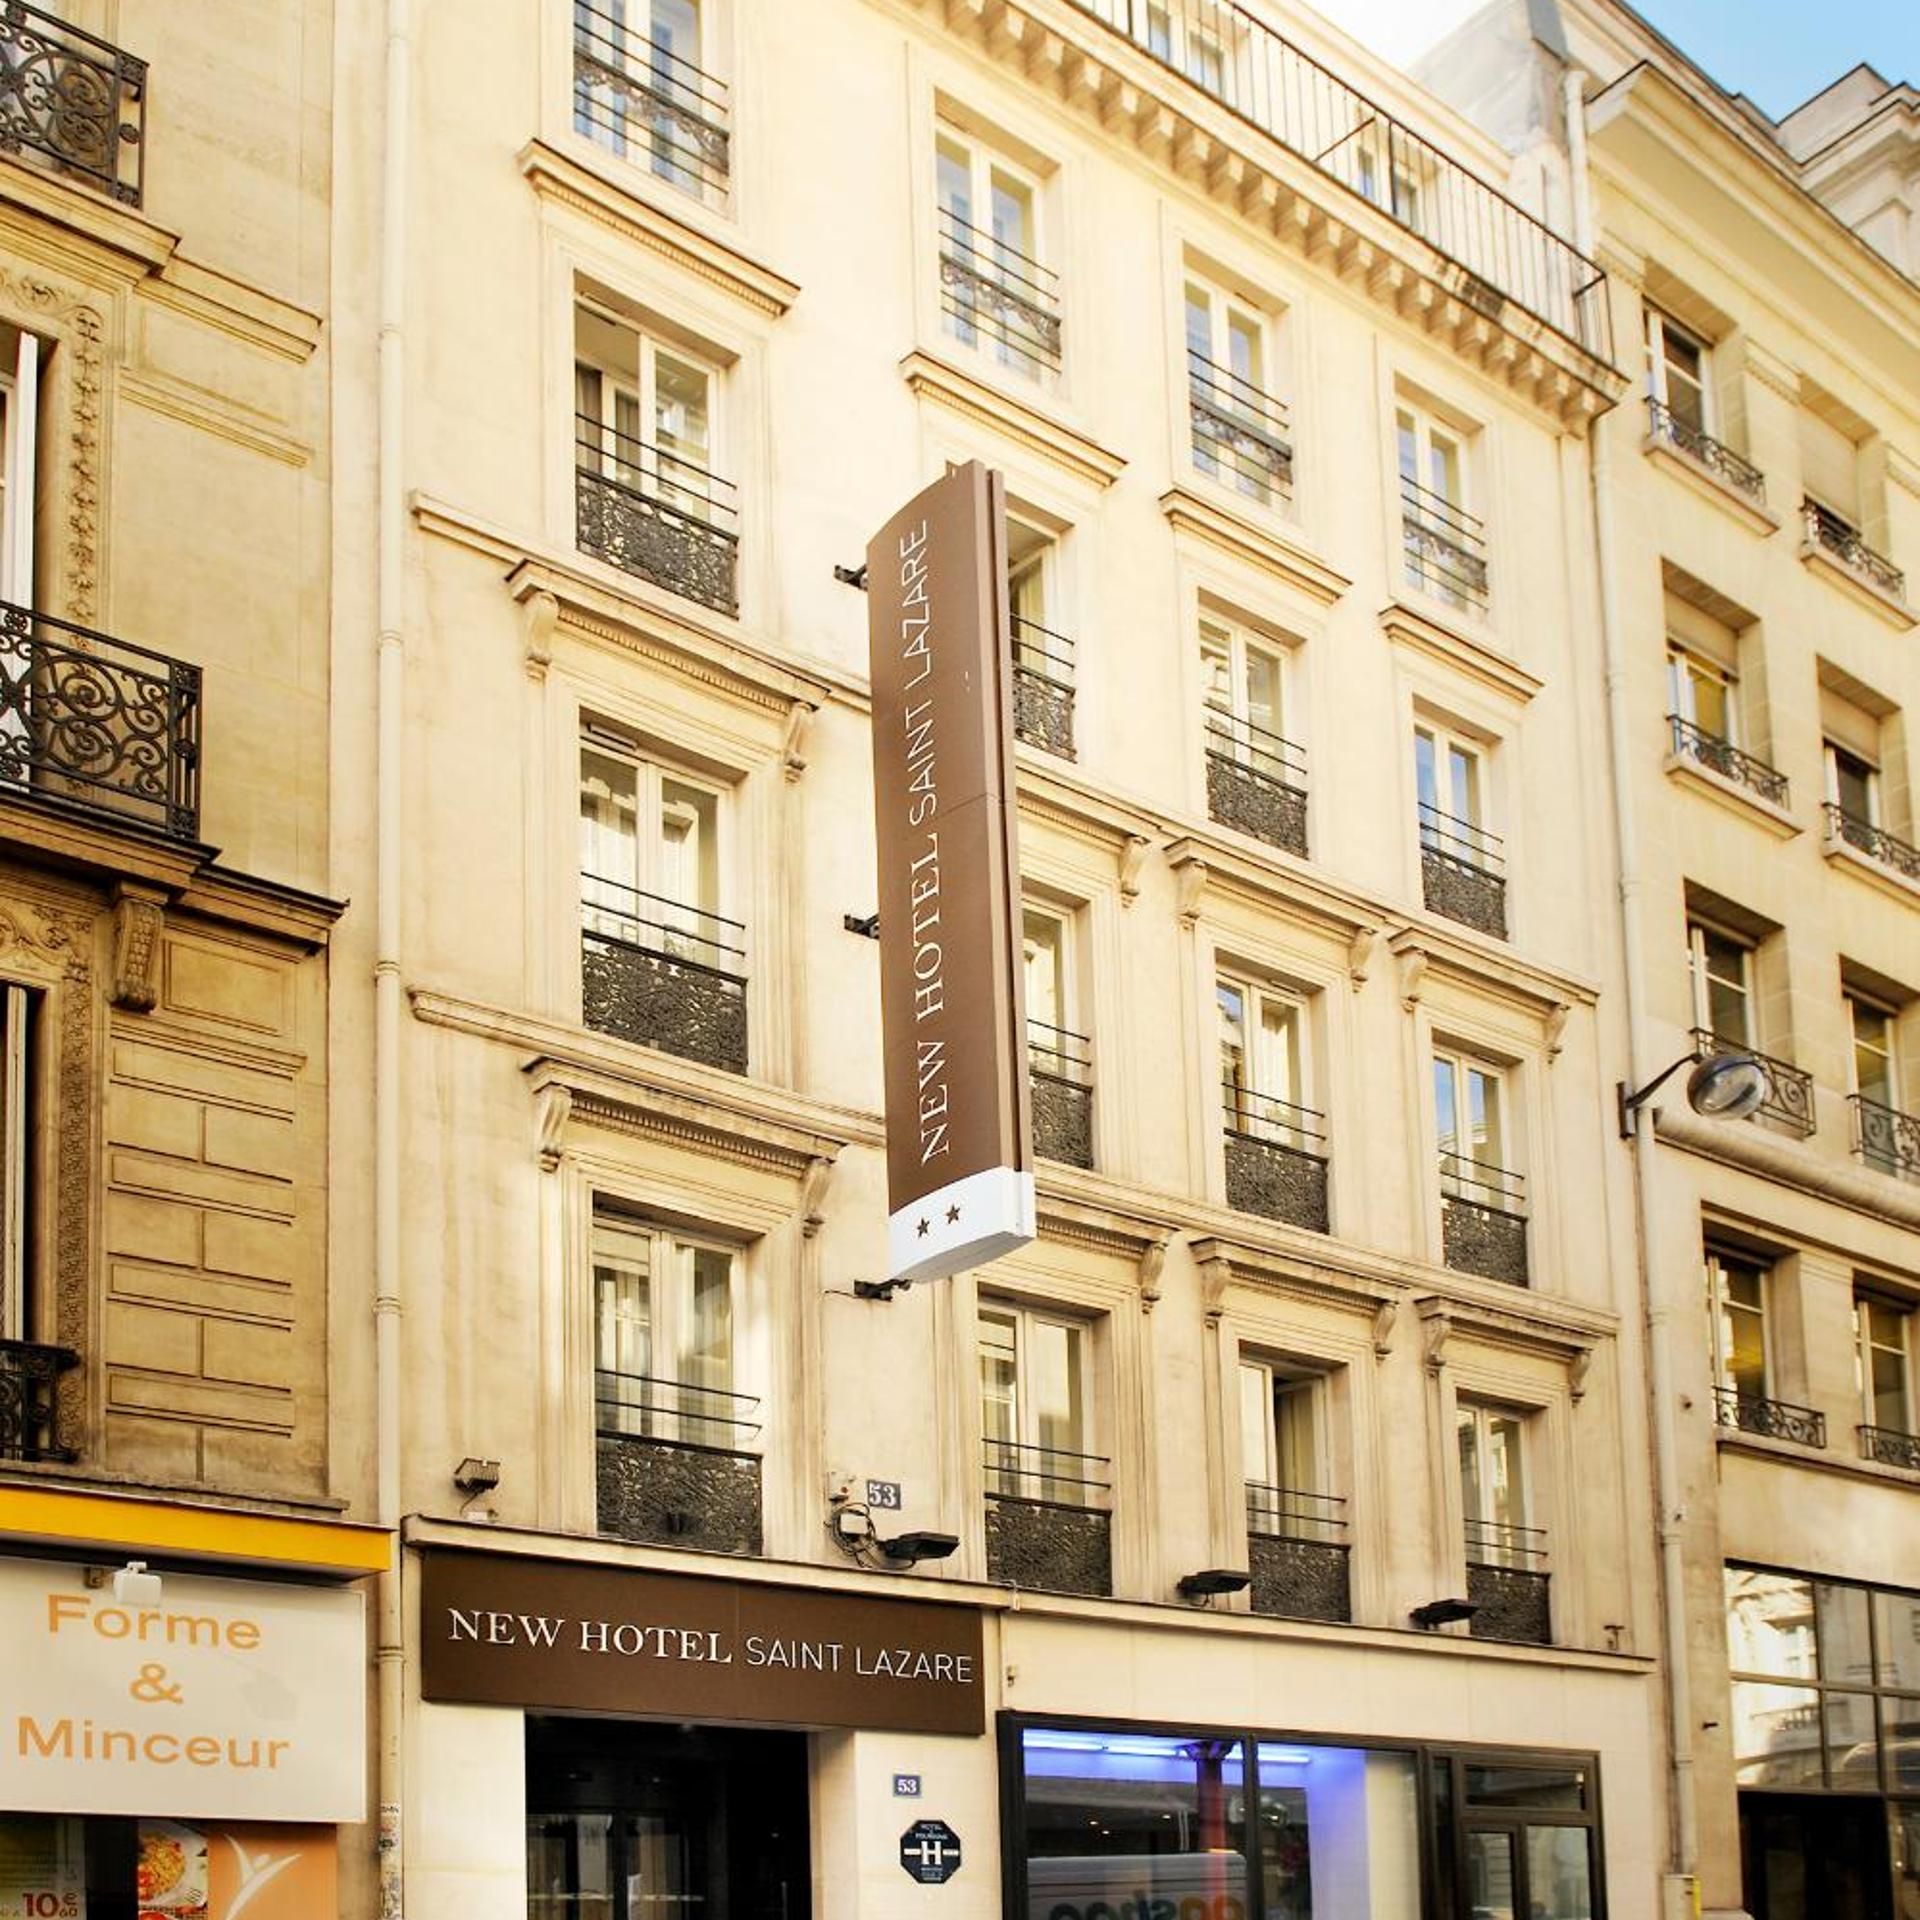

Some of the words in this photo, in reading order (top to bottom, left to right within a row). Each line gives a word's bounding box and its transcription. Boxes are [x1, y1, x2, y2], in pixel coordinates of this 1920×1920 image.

[900, 519, 931, 690] LAZARE
[905, 699, 937, 826] SAINT
[911, 832, 944, 1022] HOTEL
[917, 1039, 950, 1167] NEW
[869, 1482, 896, 1507] 53
[47, 1594, 261, 1650] Forme
[447, 1608, 566, 1647] NEW
[580, 1620, 733, 1664] HOTEL
[745, 1635, 844, 1672] SAINT
[856, 1646, 974, 1683] LAZARE
[129, 1663, 184, 1705] &
[17, 1716, 291, 1769] Minceur
[898, 1778, 918, 1794] 53
[921, 1840, 942, 1865] H
